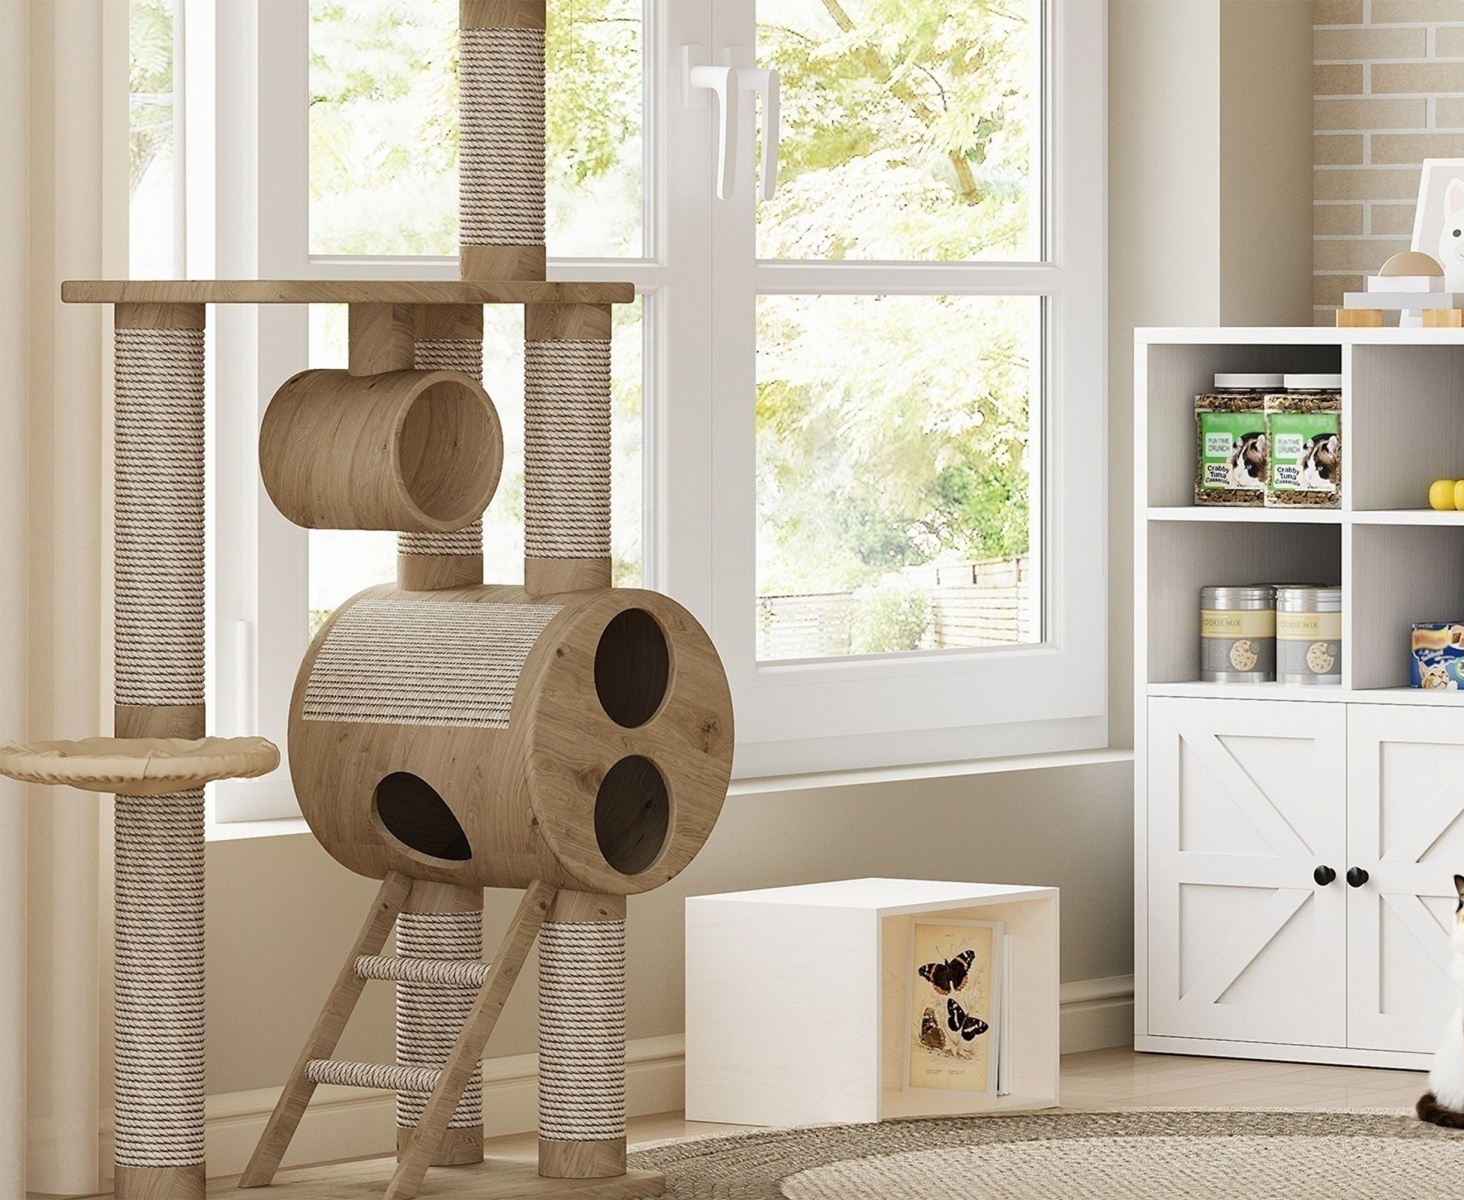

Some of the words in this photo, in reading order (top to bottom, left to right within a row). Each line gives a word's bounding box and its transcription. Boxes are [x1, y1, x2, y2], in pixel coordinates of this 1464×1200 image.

[1207, 465, 1230, 475] Crabby
[1277, 466, 1300, 476] Crabby
[1210, 471, 1227, 479] Tuna
[1280, 473, 1297, 481] Tuna
[1205, 477, 1231, 485] Casserole
[1274, 479, 1300, 487] Casserole
[1202, 619, 1224, 627] COOKIE
[1226, 619, 1241, 627] MIX
[1279, 620, 1301, 629] COOKIE
[1303, 621, 1318, 629] MIX
